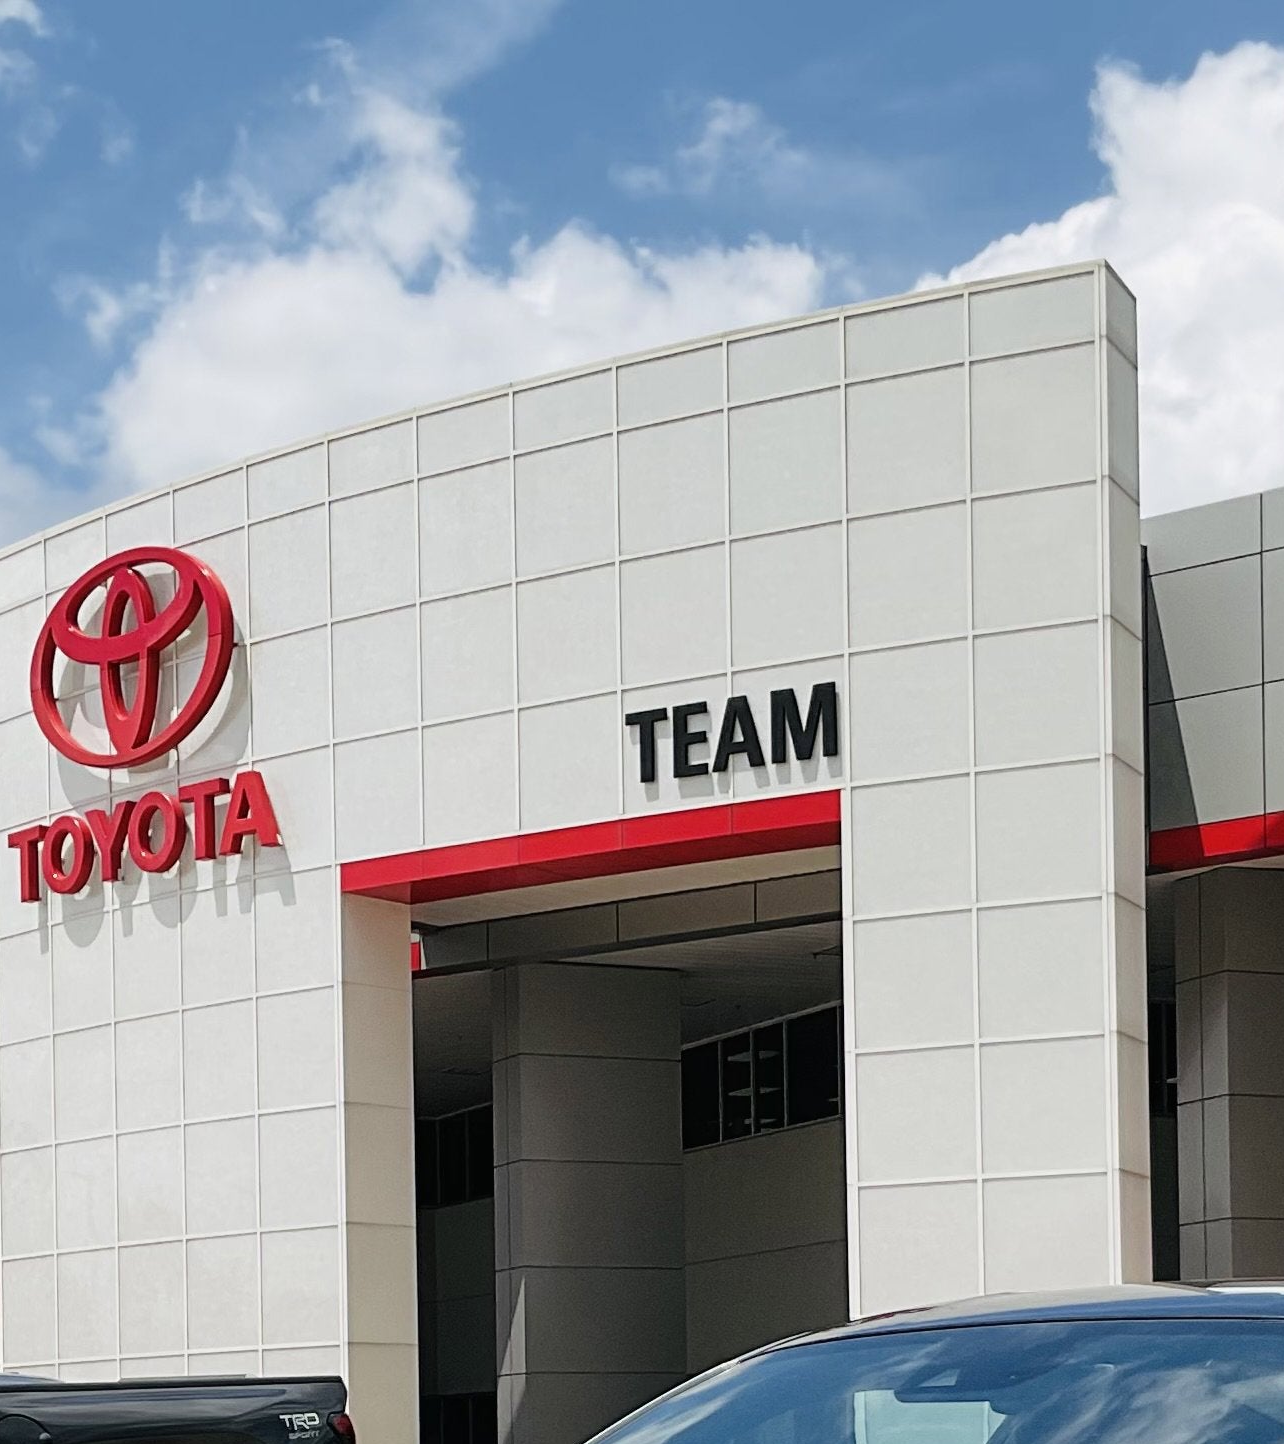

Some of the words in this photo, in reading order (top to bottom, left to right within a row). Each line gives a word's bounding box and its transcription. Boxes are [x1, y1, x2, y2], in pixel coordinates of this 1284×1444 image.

[625, 681, 838, 784] TEAM
[7, 769, 283, 904] TOYOTA
[279, 1412, 320, 1431] TRD
